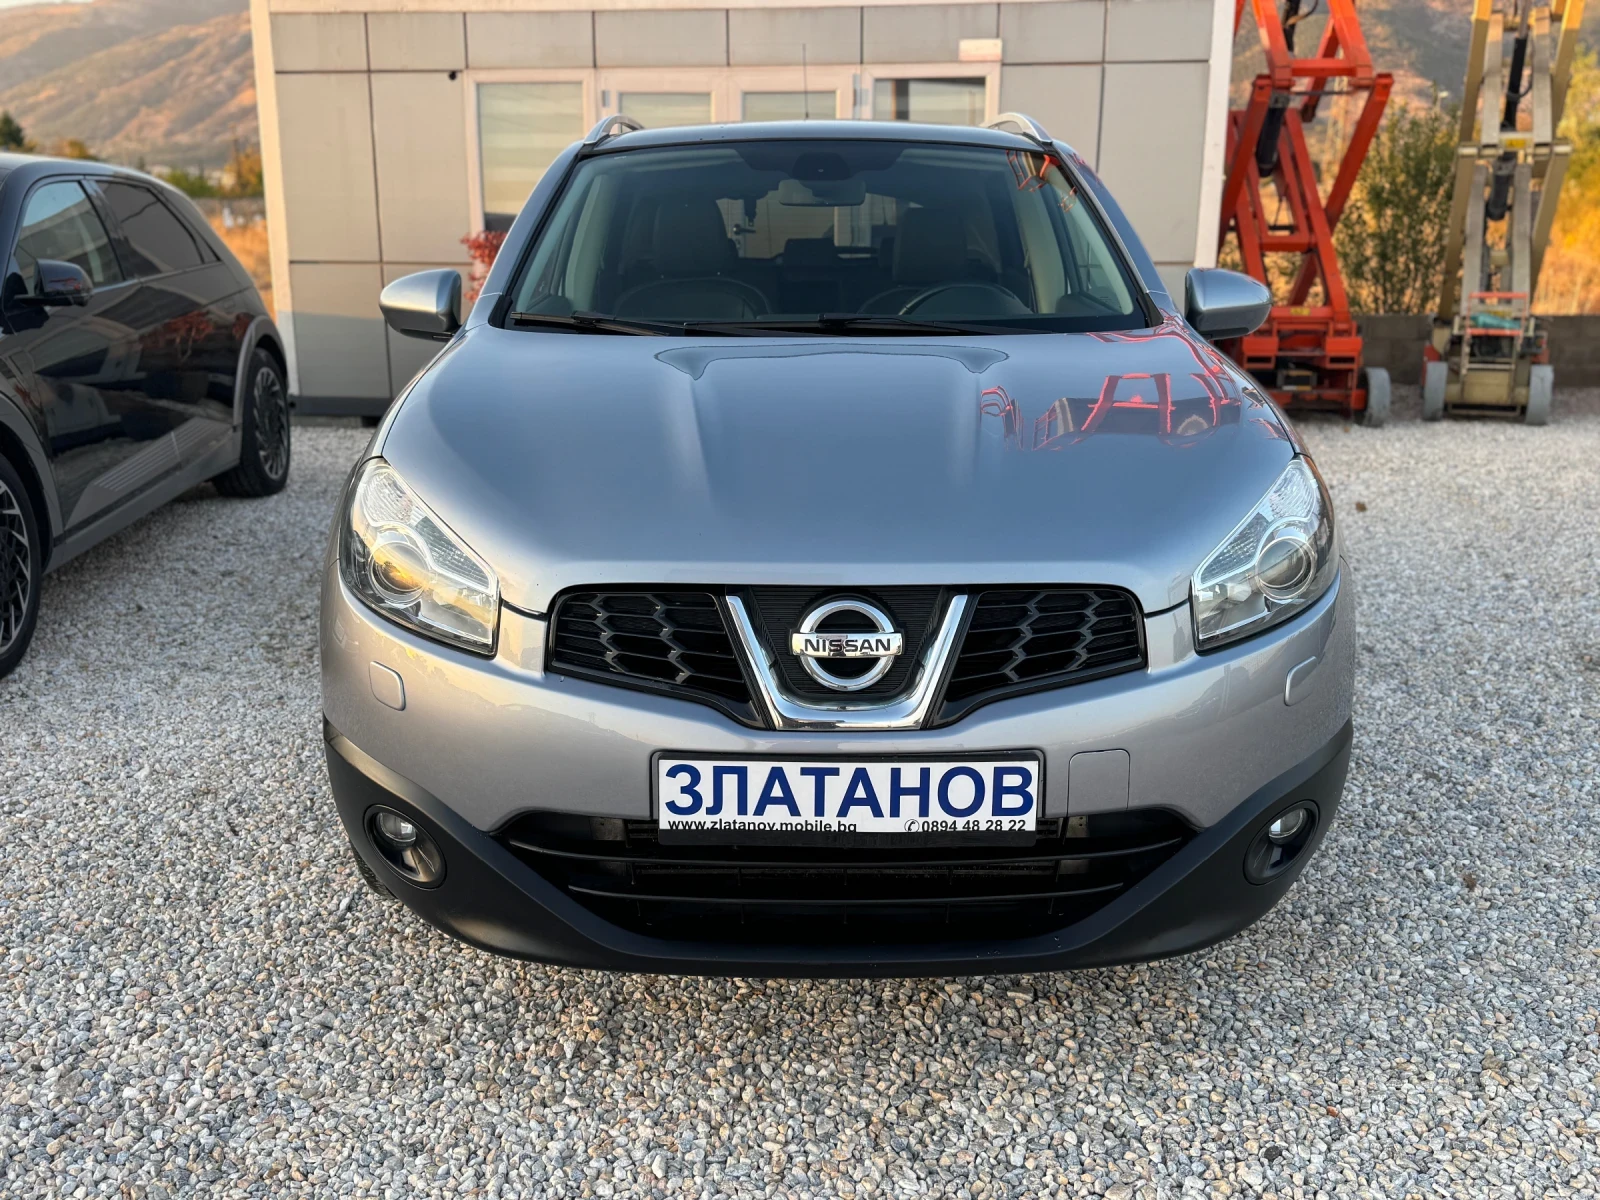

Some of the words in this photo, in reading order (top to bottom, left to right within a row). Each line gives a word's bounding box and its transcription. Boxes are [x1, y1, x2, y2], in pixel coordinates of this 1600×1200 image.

[804, 638, 891, 653] NISSAN
[665, 763, 1034, 819] ЗЛАТАНОВ
[667, 818, 857, 833] www.zlatanov.mobile.bg
[921, 820, 958, 833] 0894
[962, 819, 980, 832] 48
[985, 819, 1003, 832] 28
[1008, 819, 1026, 832] 22
